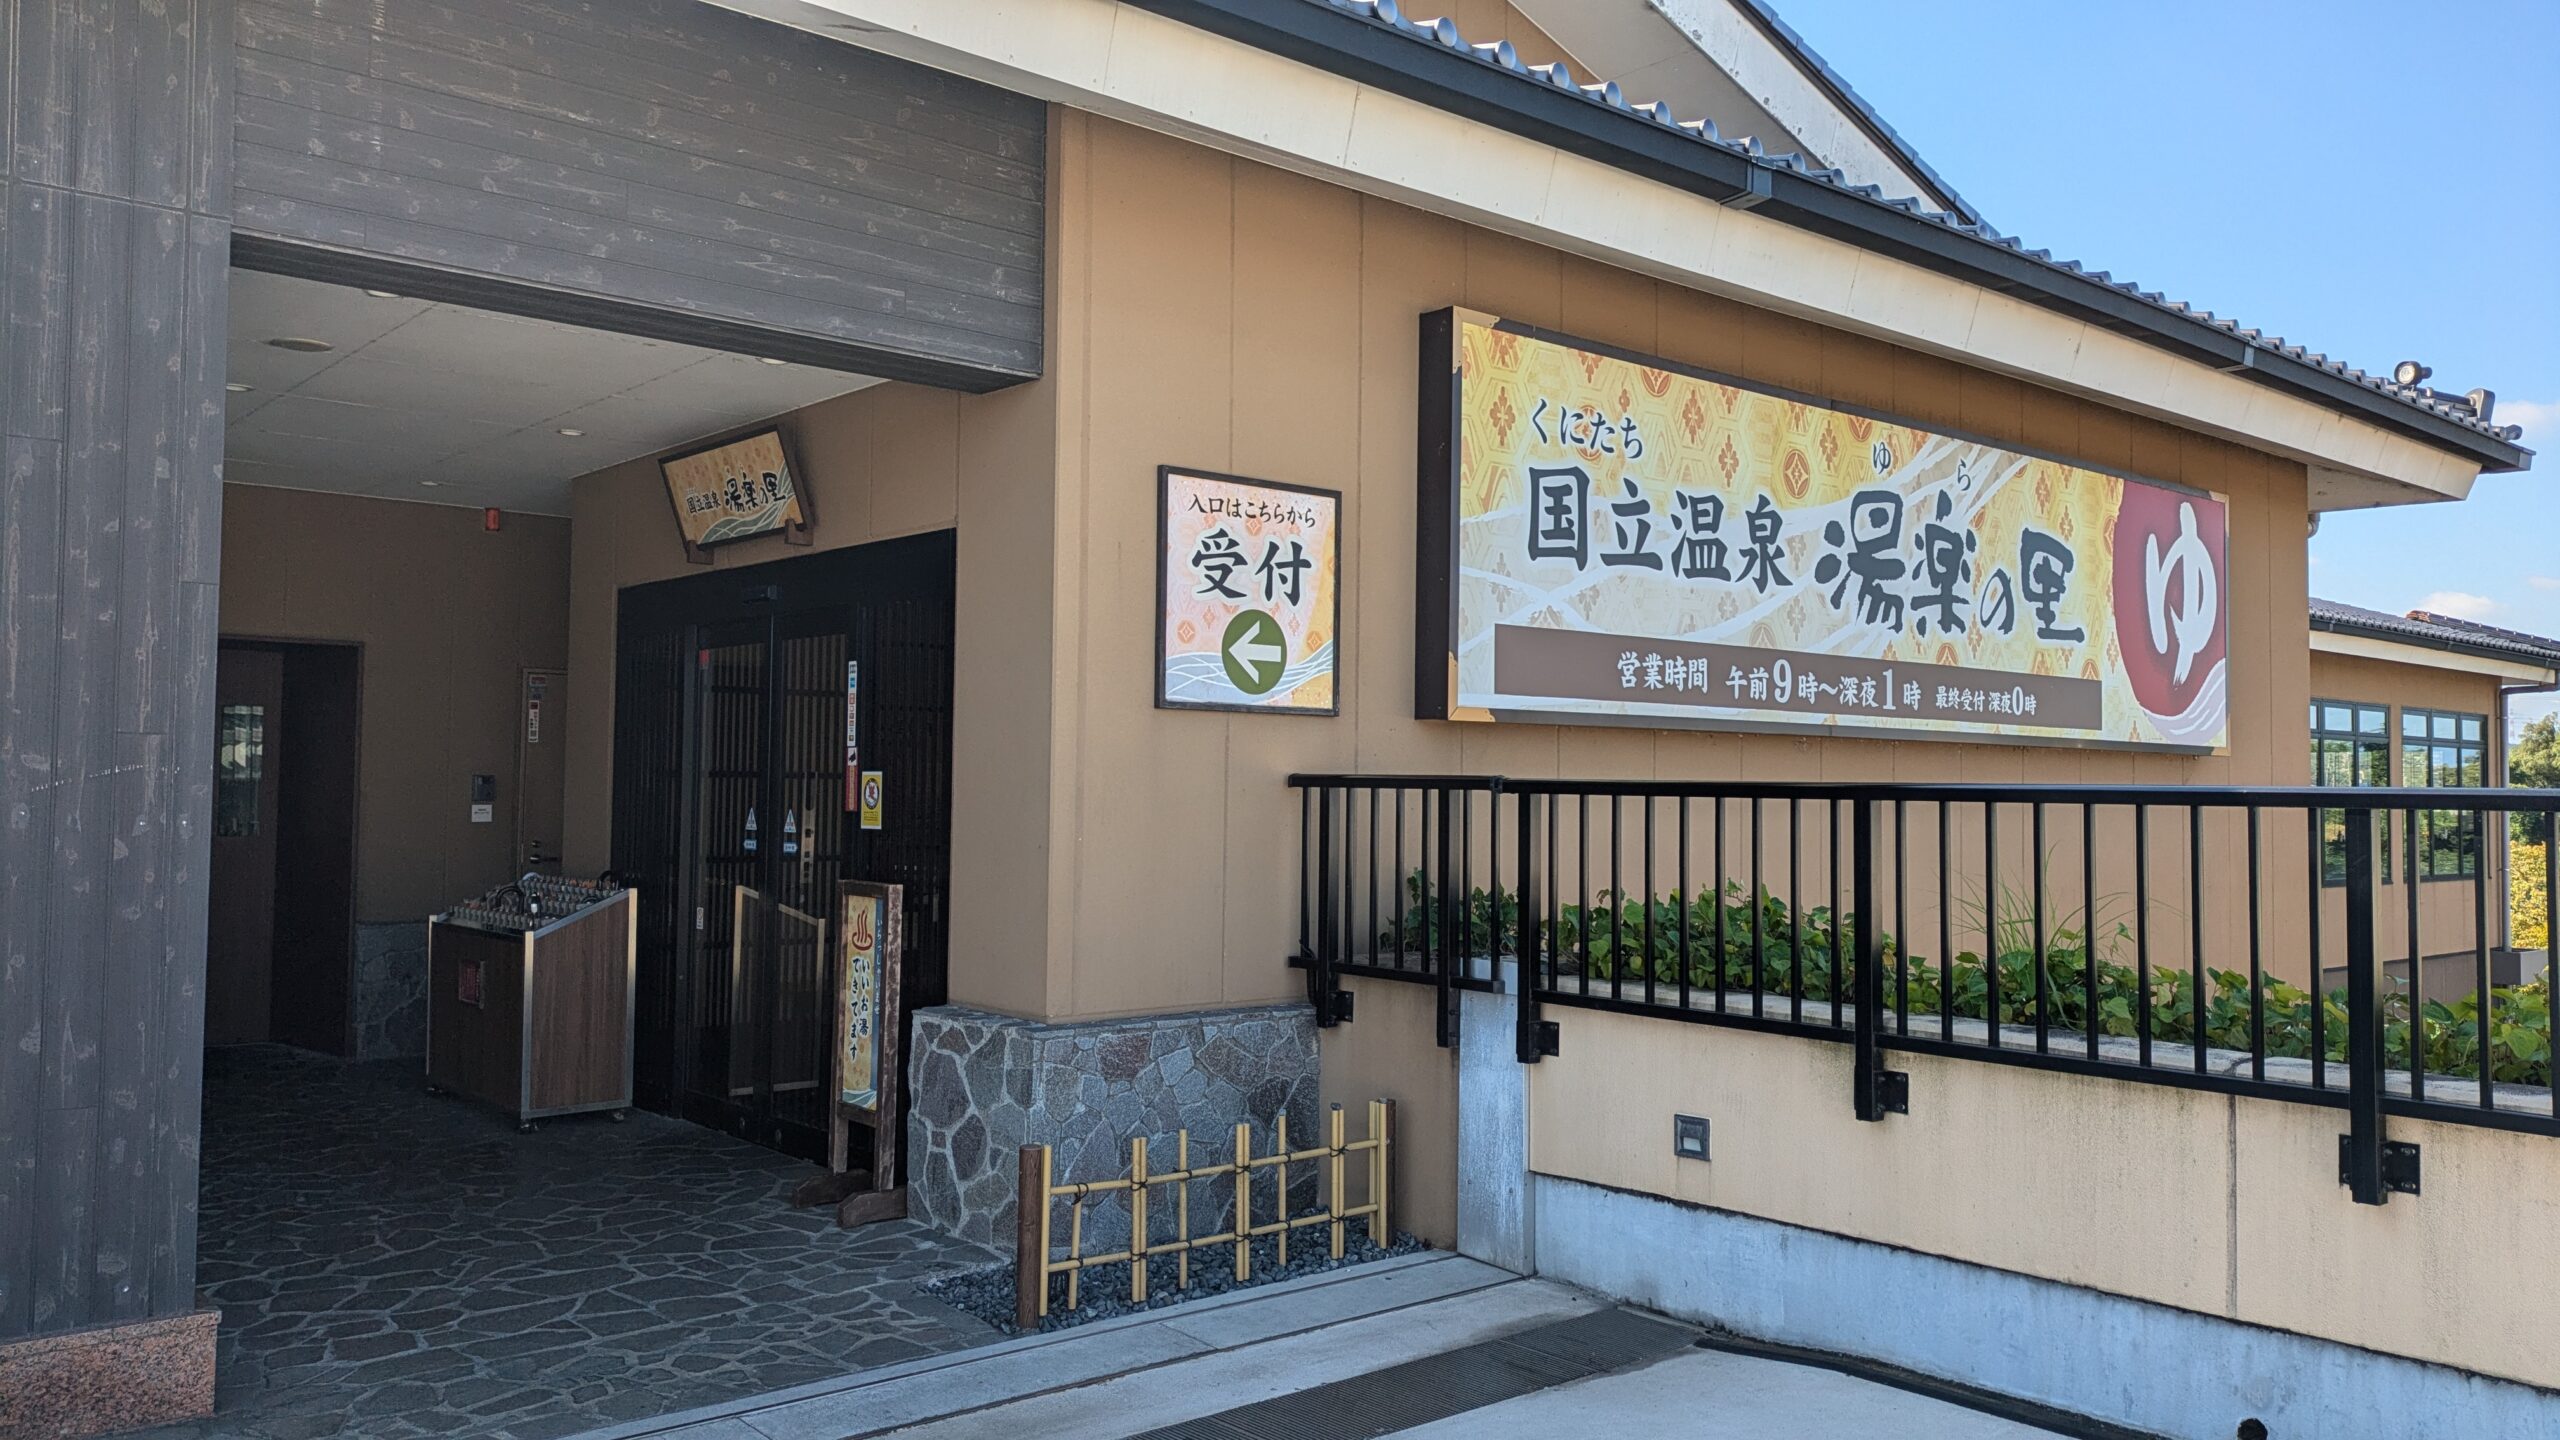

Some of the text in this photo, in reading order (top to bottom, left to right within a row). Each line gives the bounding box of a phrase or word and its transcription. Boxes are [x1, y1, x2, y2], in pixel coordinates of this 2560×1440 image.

[1531, 398, 1643, 459] くにたち
[1873, 442, 1891, 475] ゆ
[687, 491, 721, 513] 国立温泉
[1957, 463, 1971, 491] ら
[1188, 494, 1315, 528] 入口はこちらから
[1191, 527, 1312, 607] 受付
[1528, 466, 2086, 643] 国立温泉 湯楽の里
[2145, 501, 2217, 690] ゆ
[1617, 651, 1708, 694] 営業時間
[1935, 685, 1986, 713] 最終受付
[1988, 686, 2037, 716] 深夜0時
[850, 957, 861, 1061] できてます
[859, 958, 870, 1038] いいお湯
